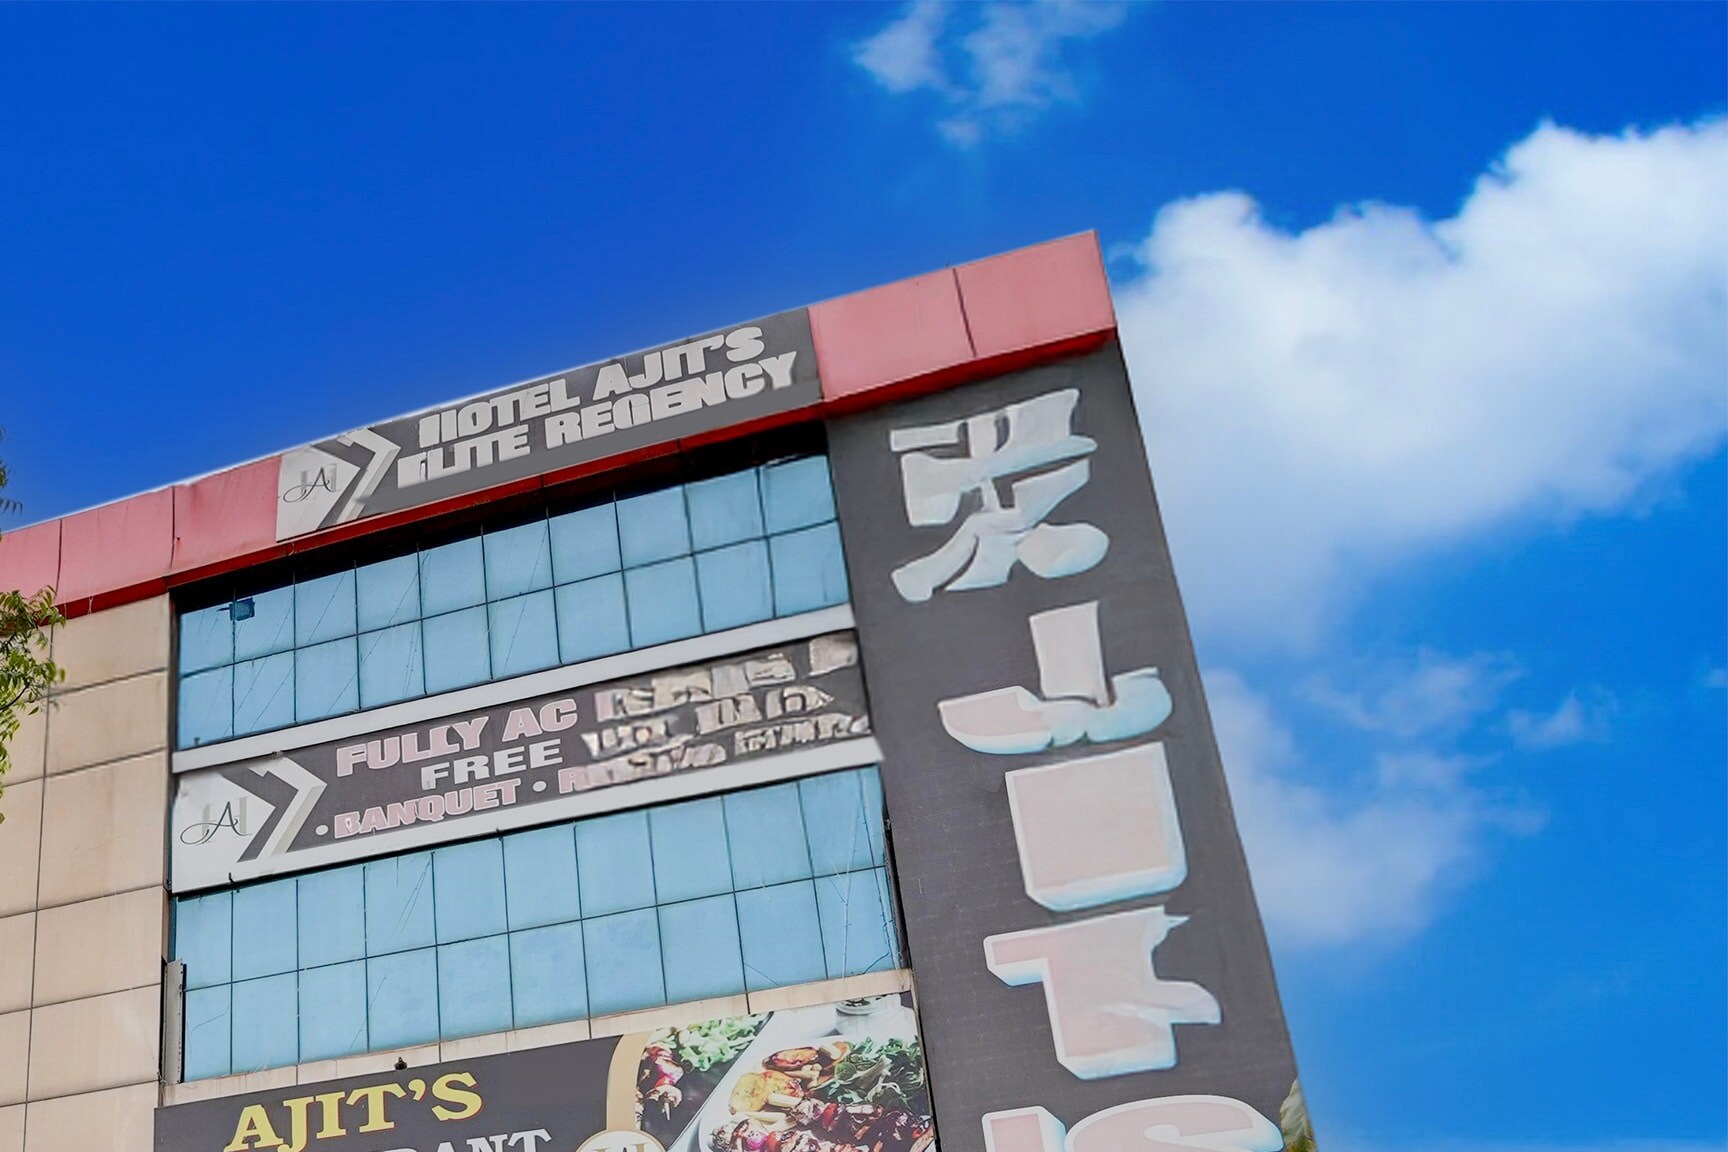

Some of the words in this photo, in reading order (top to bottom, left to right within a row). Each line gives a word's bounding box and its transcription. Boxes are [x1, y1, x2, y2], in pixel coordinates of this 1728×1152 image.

[593, 325, 766, 398] AJIT'S
[544, 350, 798, 451] REGENCY
[336, 715, 490, 778] FULLY
[503, 698, 578, 741] AC
[420, 737, 564, 790] FREE
[334, 780, 521, 839] BANQUET
